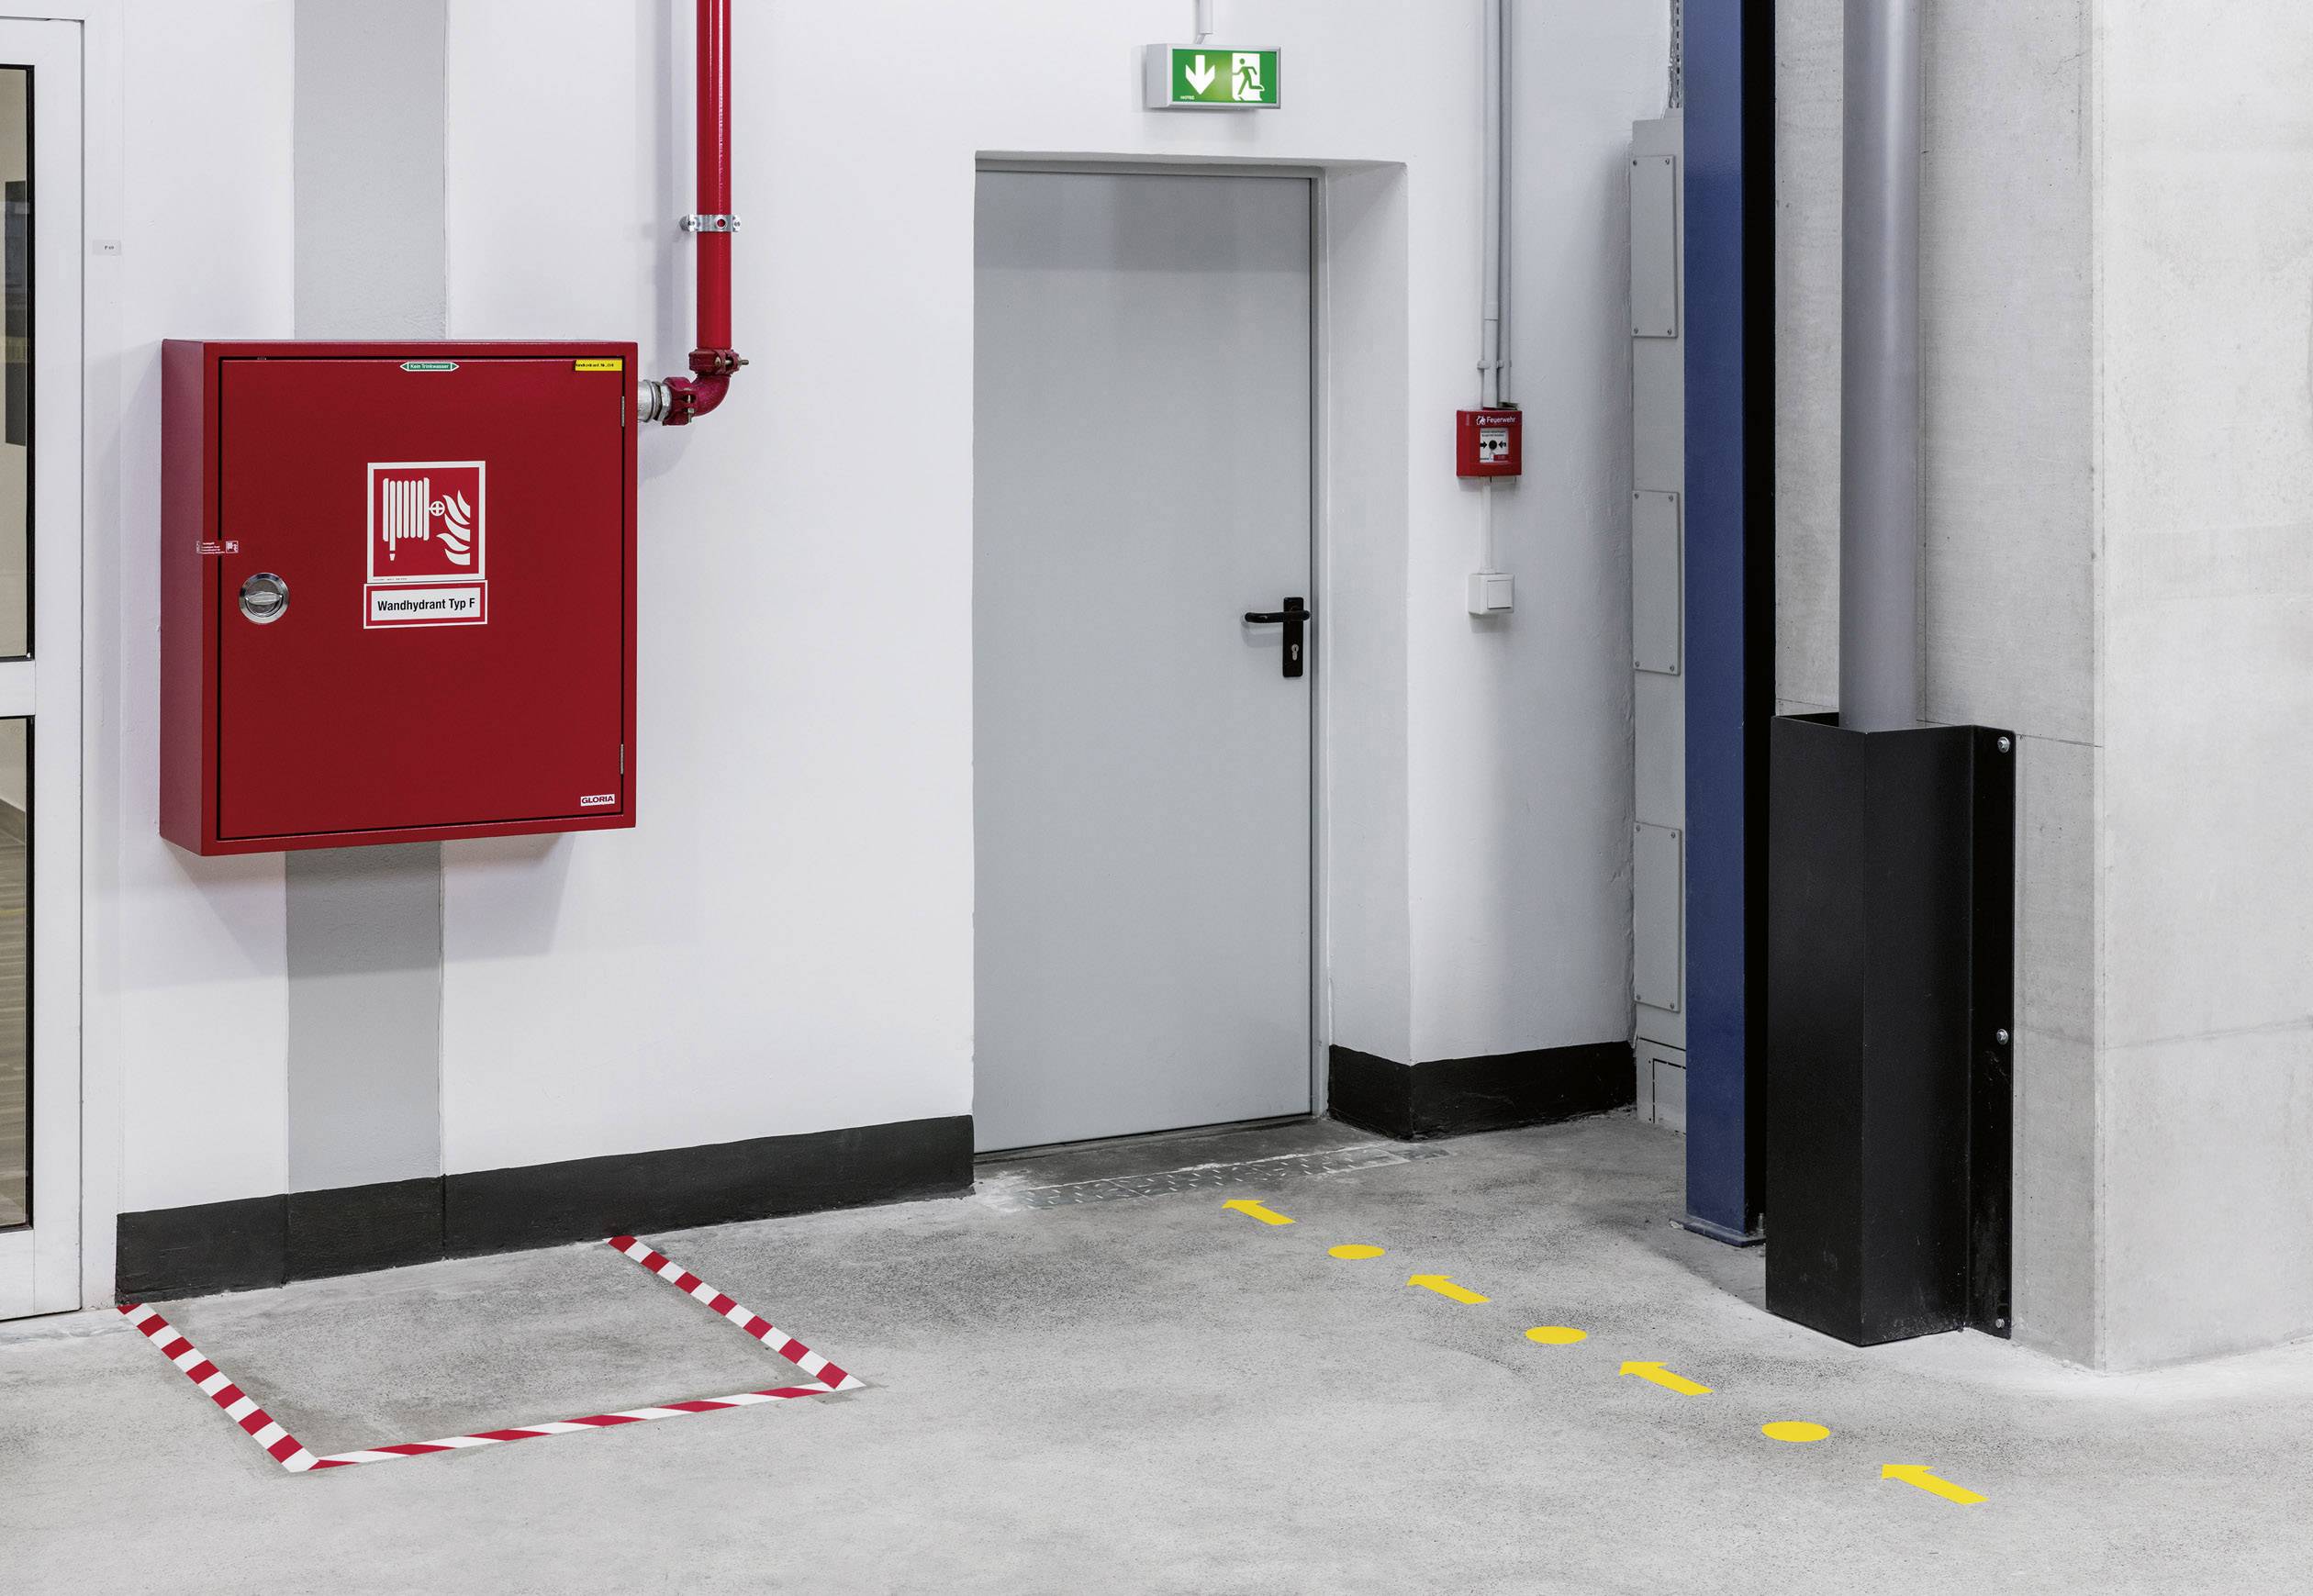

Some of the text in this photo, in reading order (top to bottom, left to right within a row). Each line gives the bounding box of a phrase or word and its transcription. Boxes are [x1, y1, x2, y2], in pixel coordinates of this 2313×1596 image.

[377, 597, 475, 612] Wandhydrant Typ F
[581, 795, 614, 804] GLORIA
